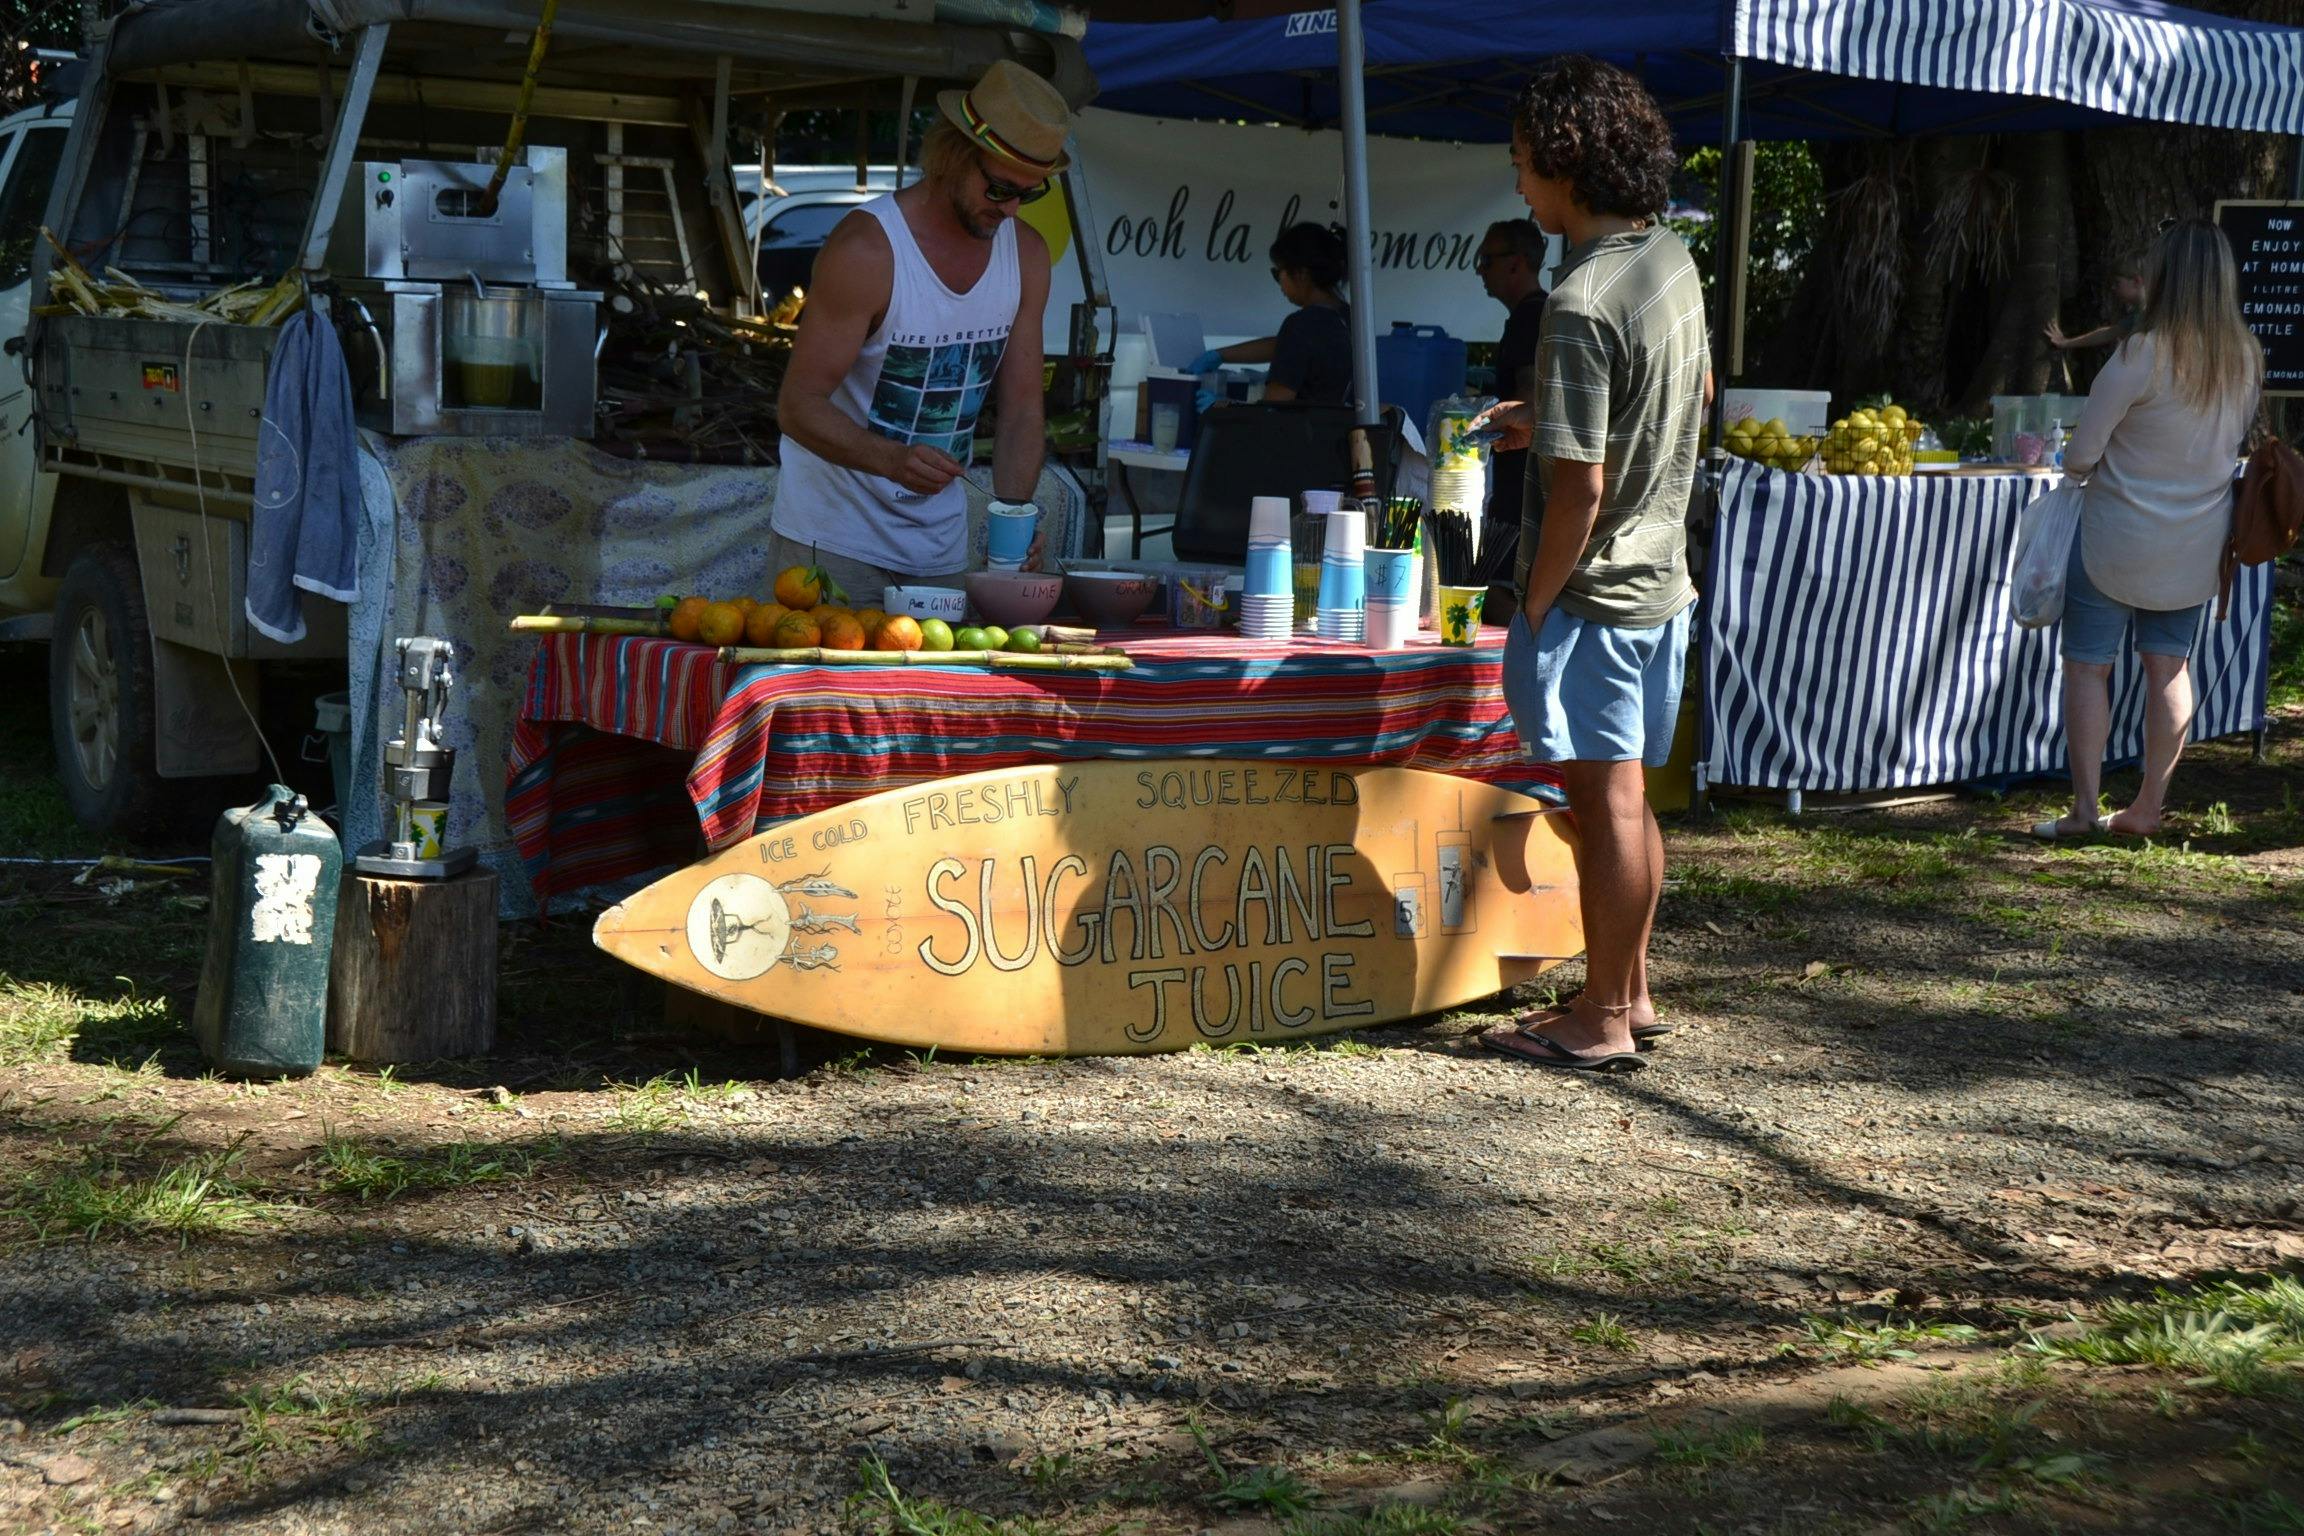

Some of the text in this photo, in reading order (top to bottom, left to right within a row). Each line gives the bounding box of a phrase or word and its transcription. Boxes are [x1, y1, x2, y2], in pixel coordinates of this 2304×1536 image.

[1107, 185, 1189, 259] ooh
[1206, 189, 1252, 263] la
[2267, 219, 2292, 231] NOW
[2252, 241, 2300, 252] ENJOY
[2242, 261, 2259, 272] AT
[2262, 285, 2299, 294] LITRE
[2243, 303, 2304, 314] EMONAD
[892, 325, 1011, 344] LIFE IS BETTER
[2250, 324, 2293, 335] OTTLE
[2264, 370, 2304, 379] EMONAD
[1375, 564, 1406, 589] $7
[1022, 585, 1057, 600] LIME
[903, 768, 1359, 834] FRESHLY SQUEEZED
[760, 819, 868, 863] ICE COLD
[918, 843, 1375, 976] SUGARCANE
[1124, 953, 1373, 1043] JUICE
